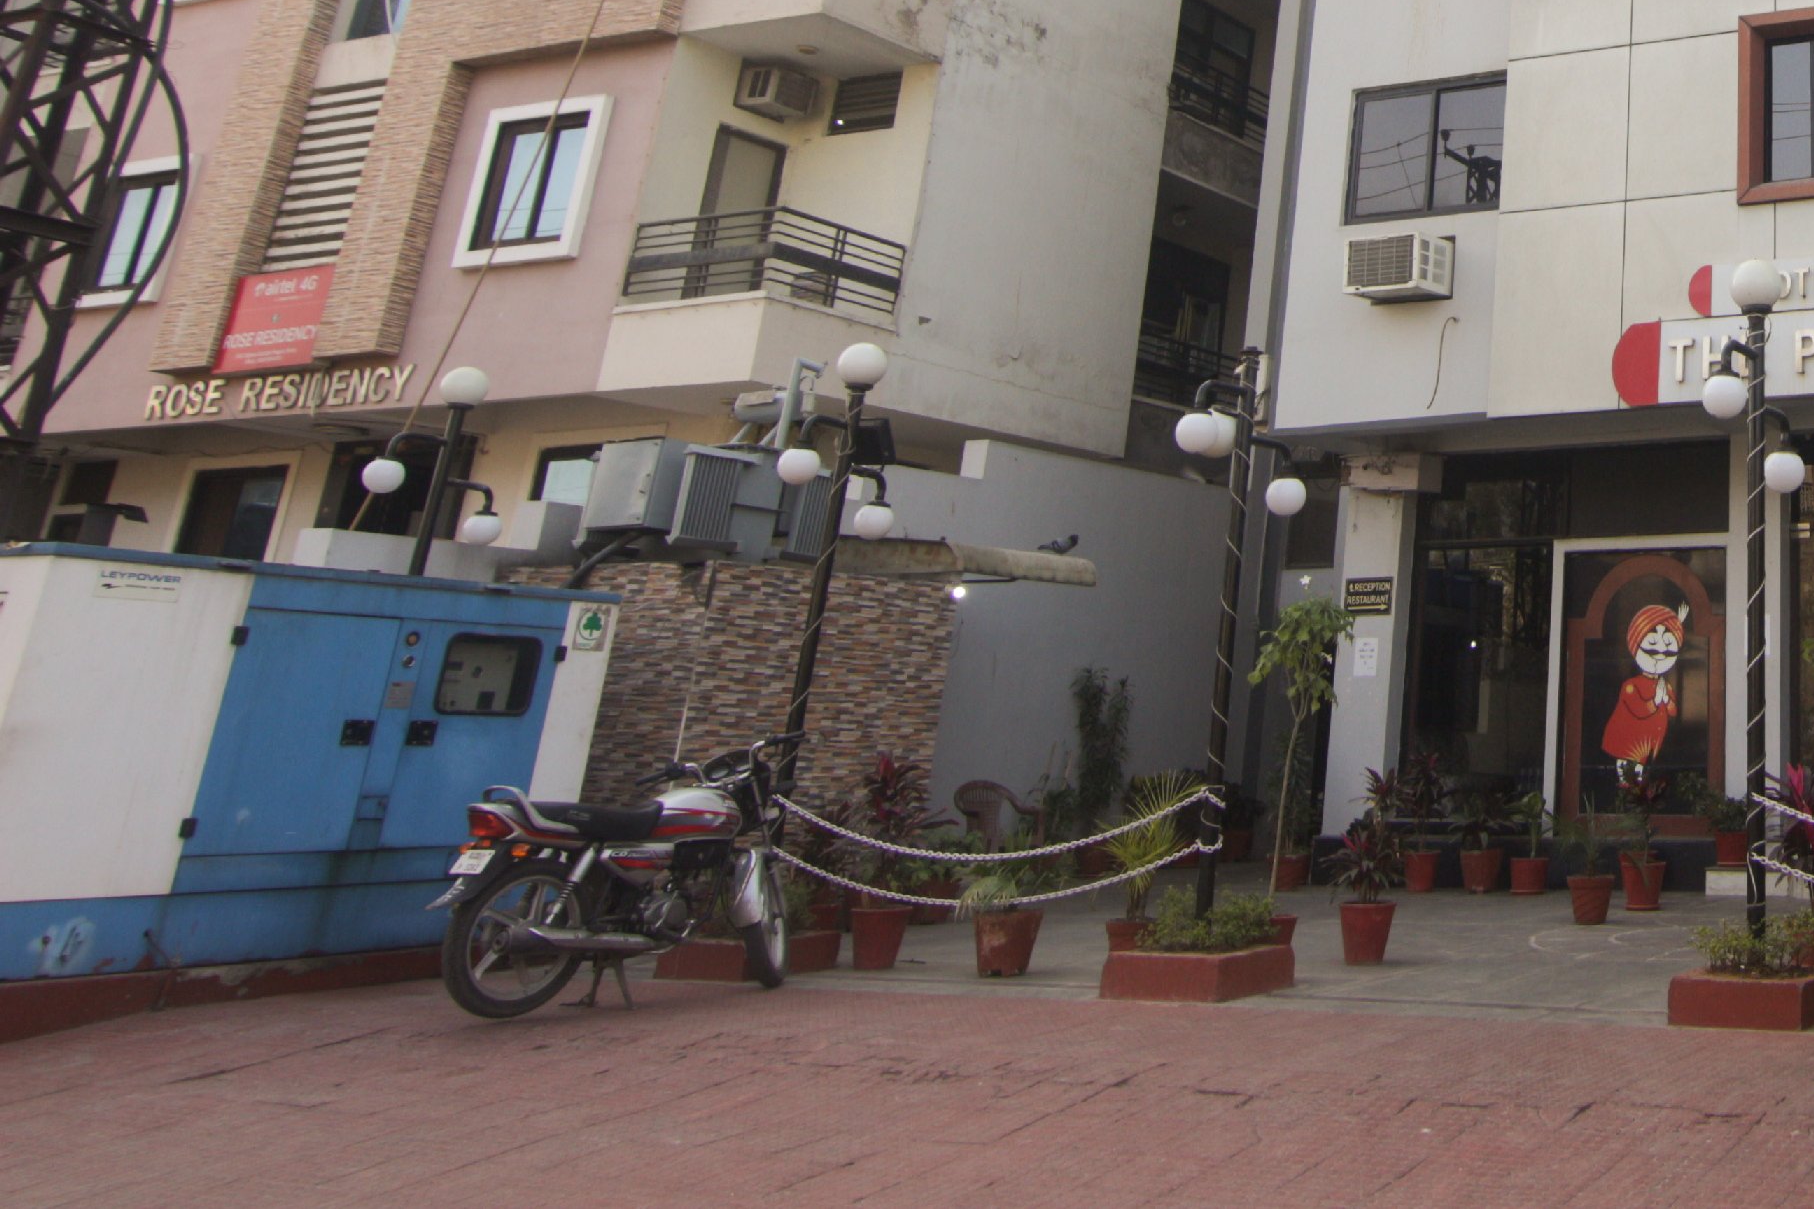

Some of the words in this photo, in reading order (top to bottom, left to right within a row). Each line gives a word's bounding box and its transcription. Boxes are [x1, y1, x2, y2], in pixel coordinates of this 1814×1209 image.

[265, 279, 298, 296] airtel
[299, 275, 319, 291] 4G
[223, 332, 256, 349] ROSE
[255, 325, 318, 345] RESIDENCY
[145, 378, 227, 420] ROSE
[240, 363, 416, 412] RESIDENCY
[101, 570, 182, 583] LEYPOWER
[1354, 582, 1391, 592] RECEPTION
[1347, 594, 1389, 605] RESTAURANT
